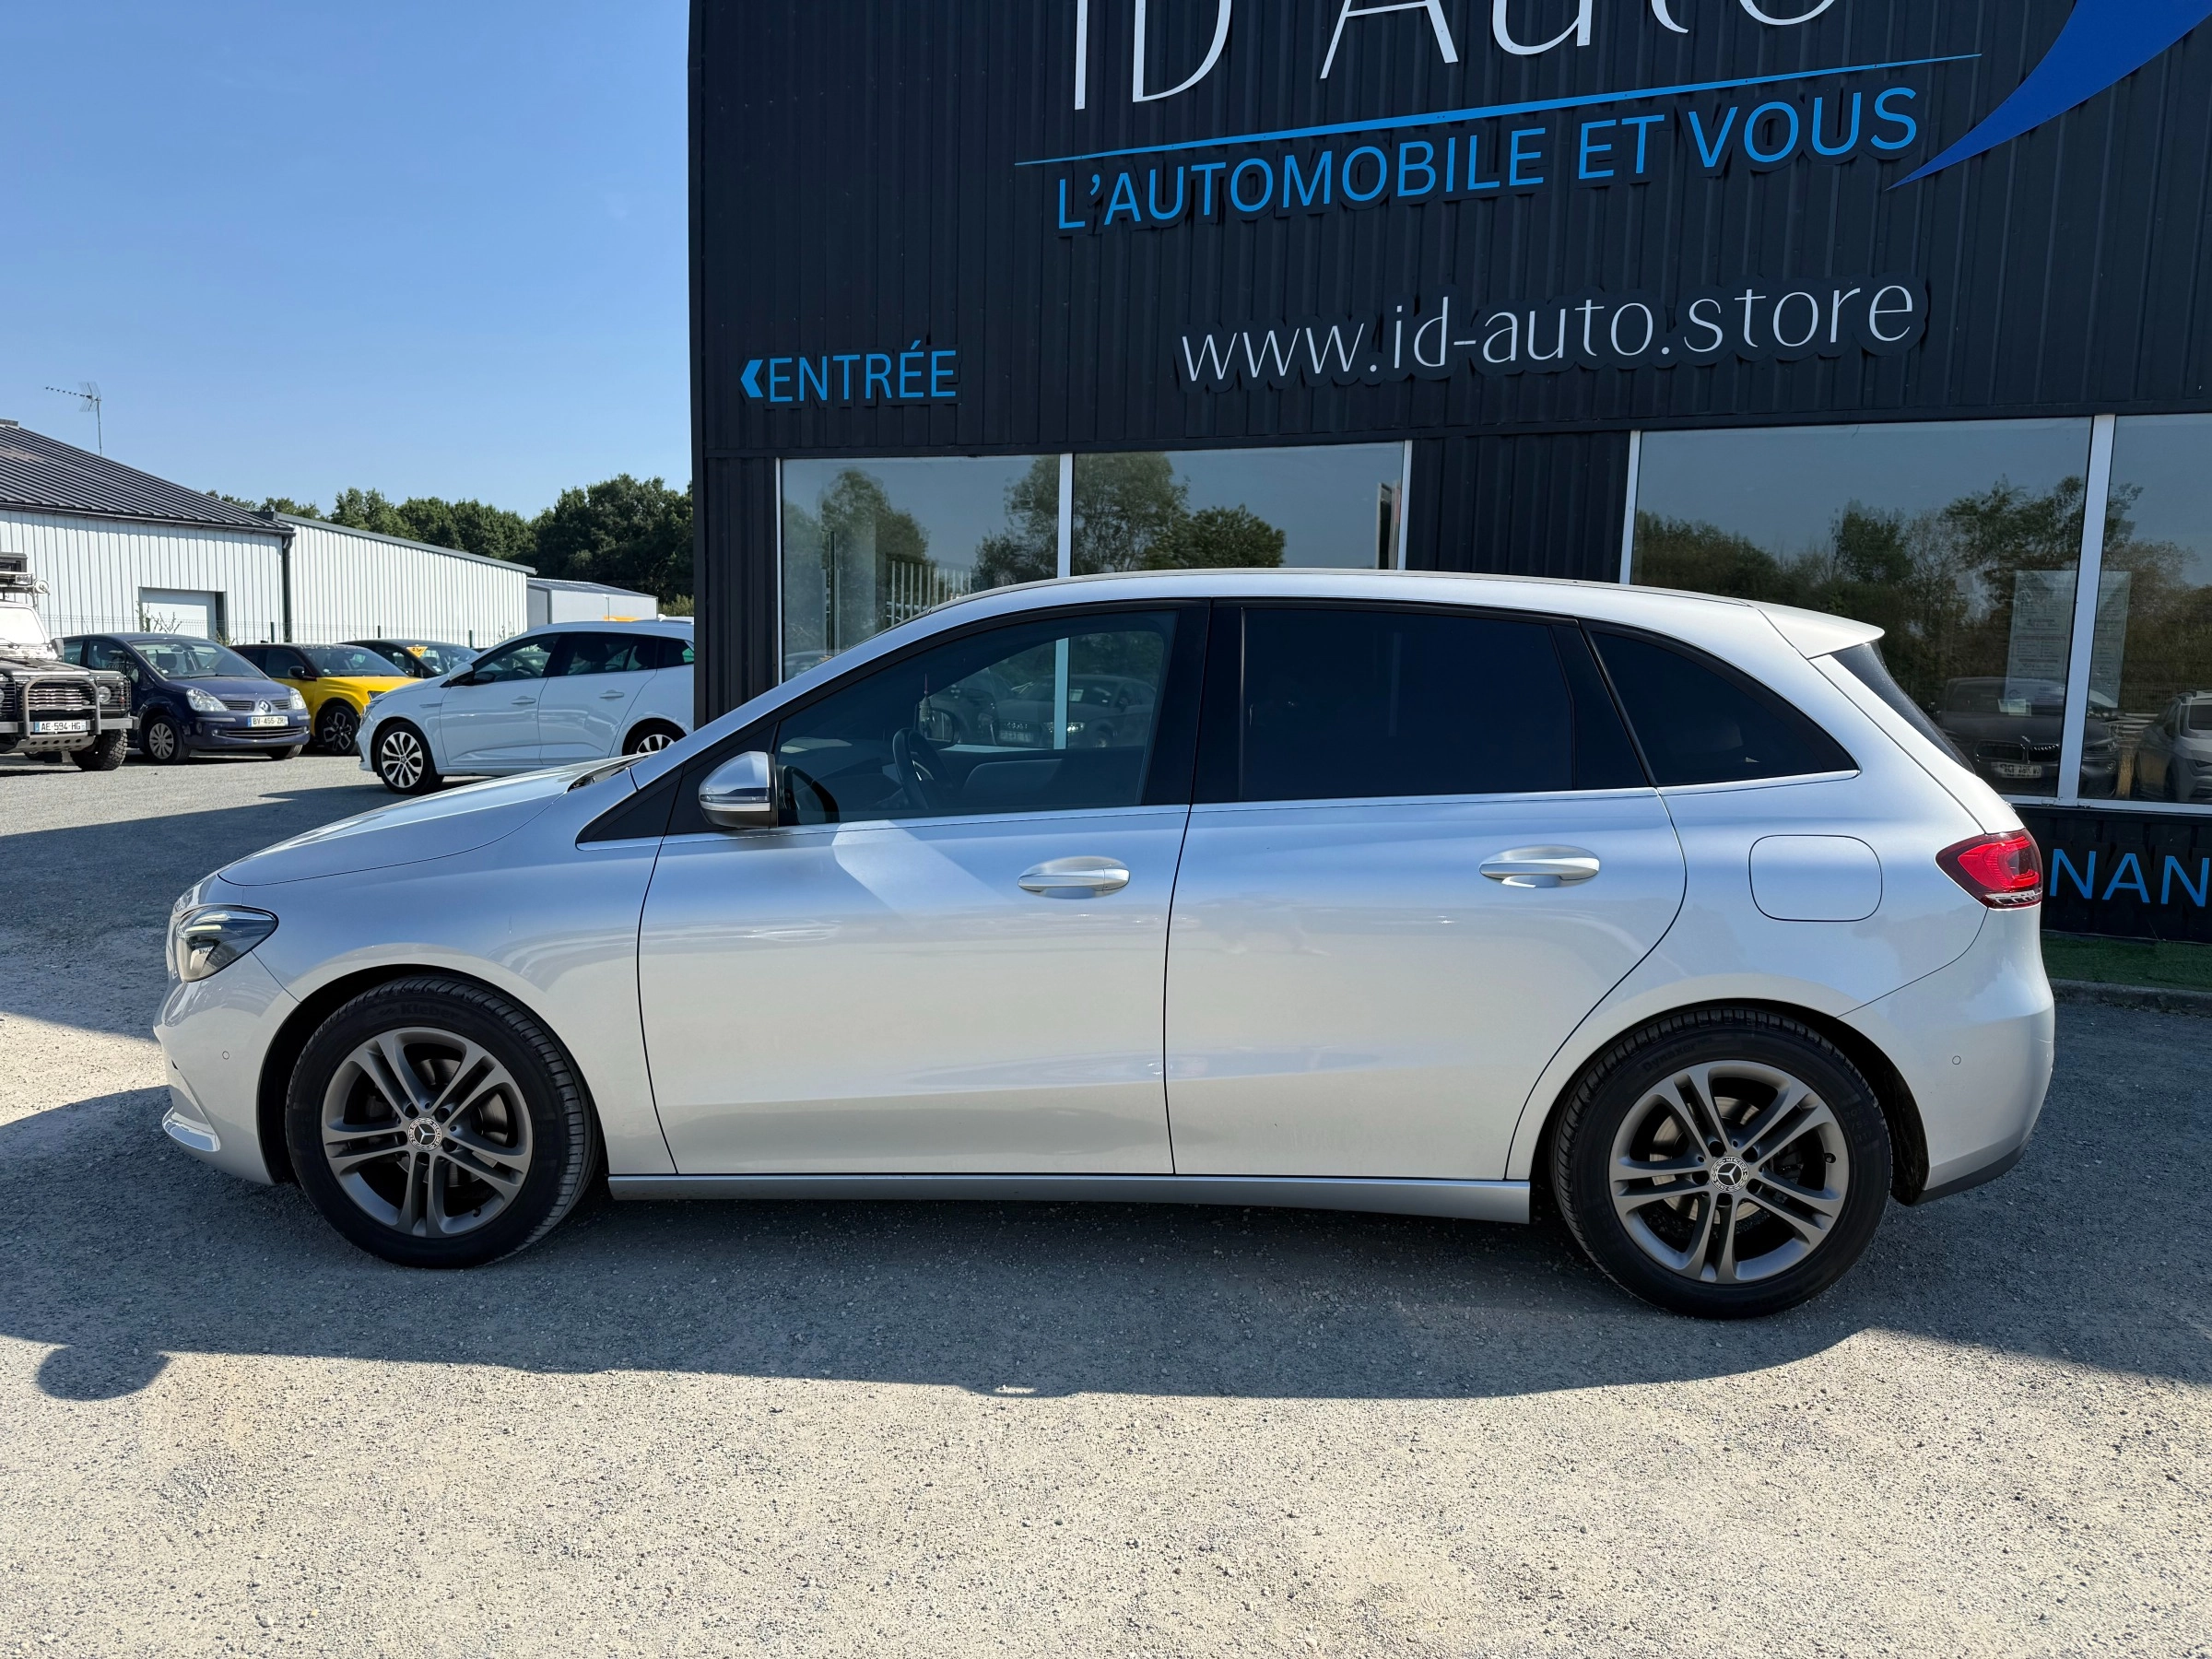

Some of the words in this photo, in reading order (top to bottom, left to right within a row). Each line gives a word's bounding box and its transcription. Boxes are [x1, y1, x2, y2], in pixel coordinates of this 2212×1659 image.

[1578, 114, 1665, 181] ET
[1688, 87, 1918, 168] VOUS
[1181, 285, 1915, 382] www.id-auto.store
[769, 339, 957, 403] ENTRÉE
[41, 722, 81, 731] AE-594-HG
[399, 1001, 460, 1019] Kleber
